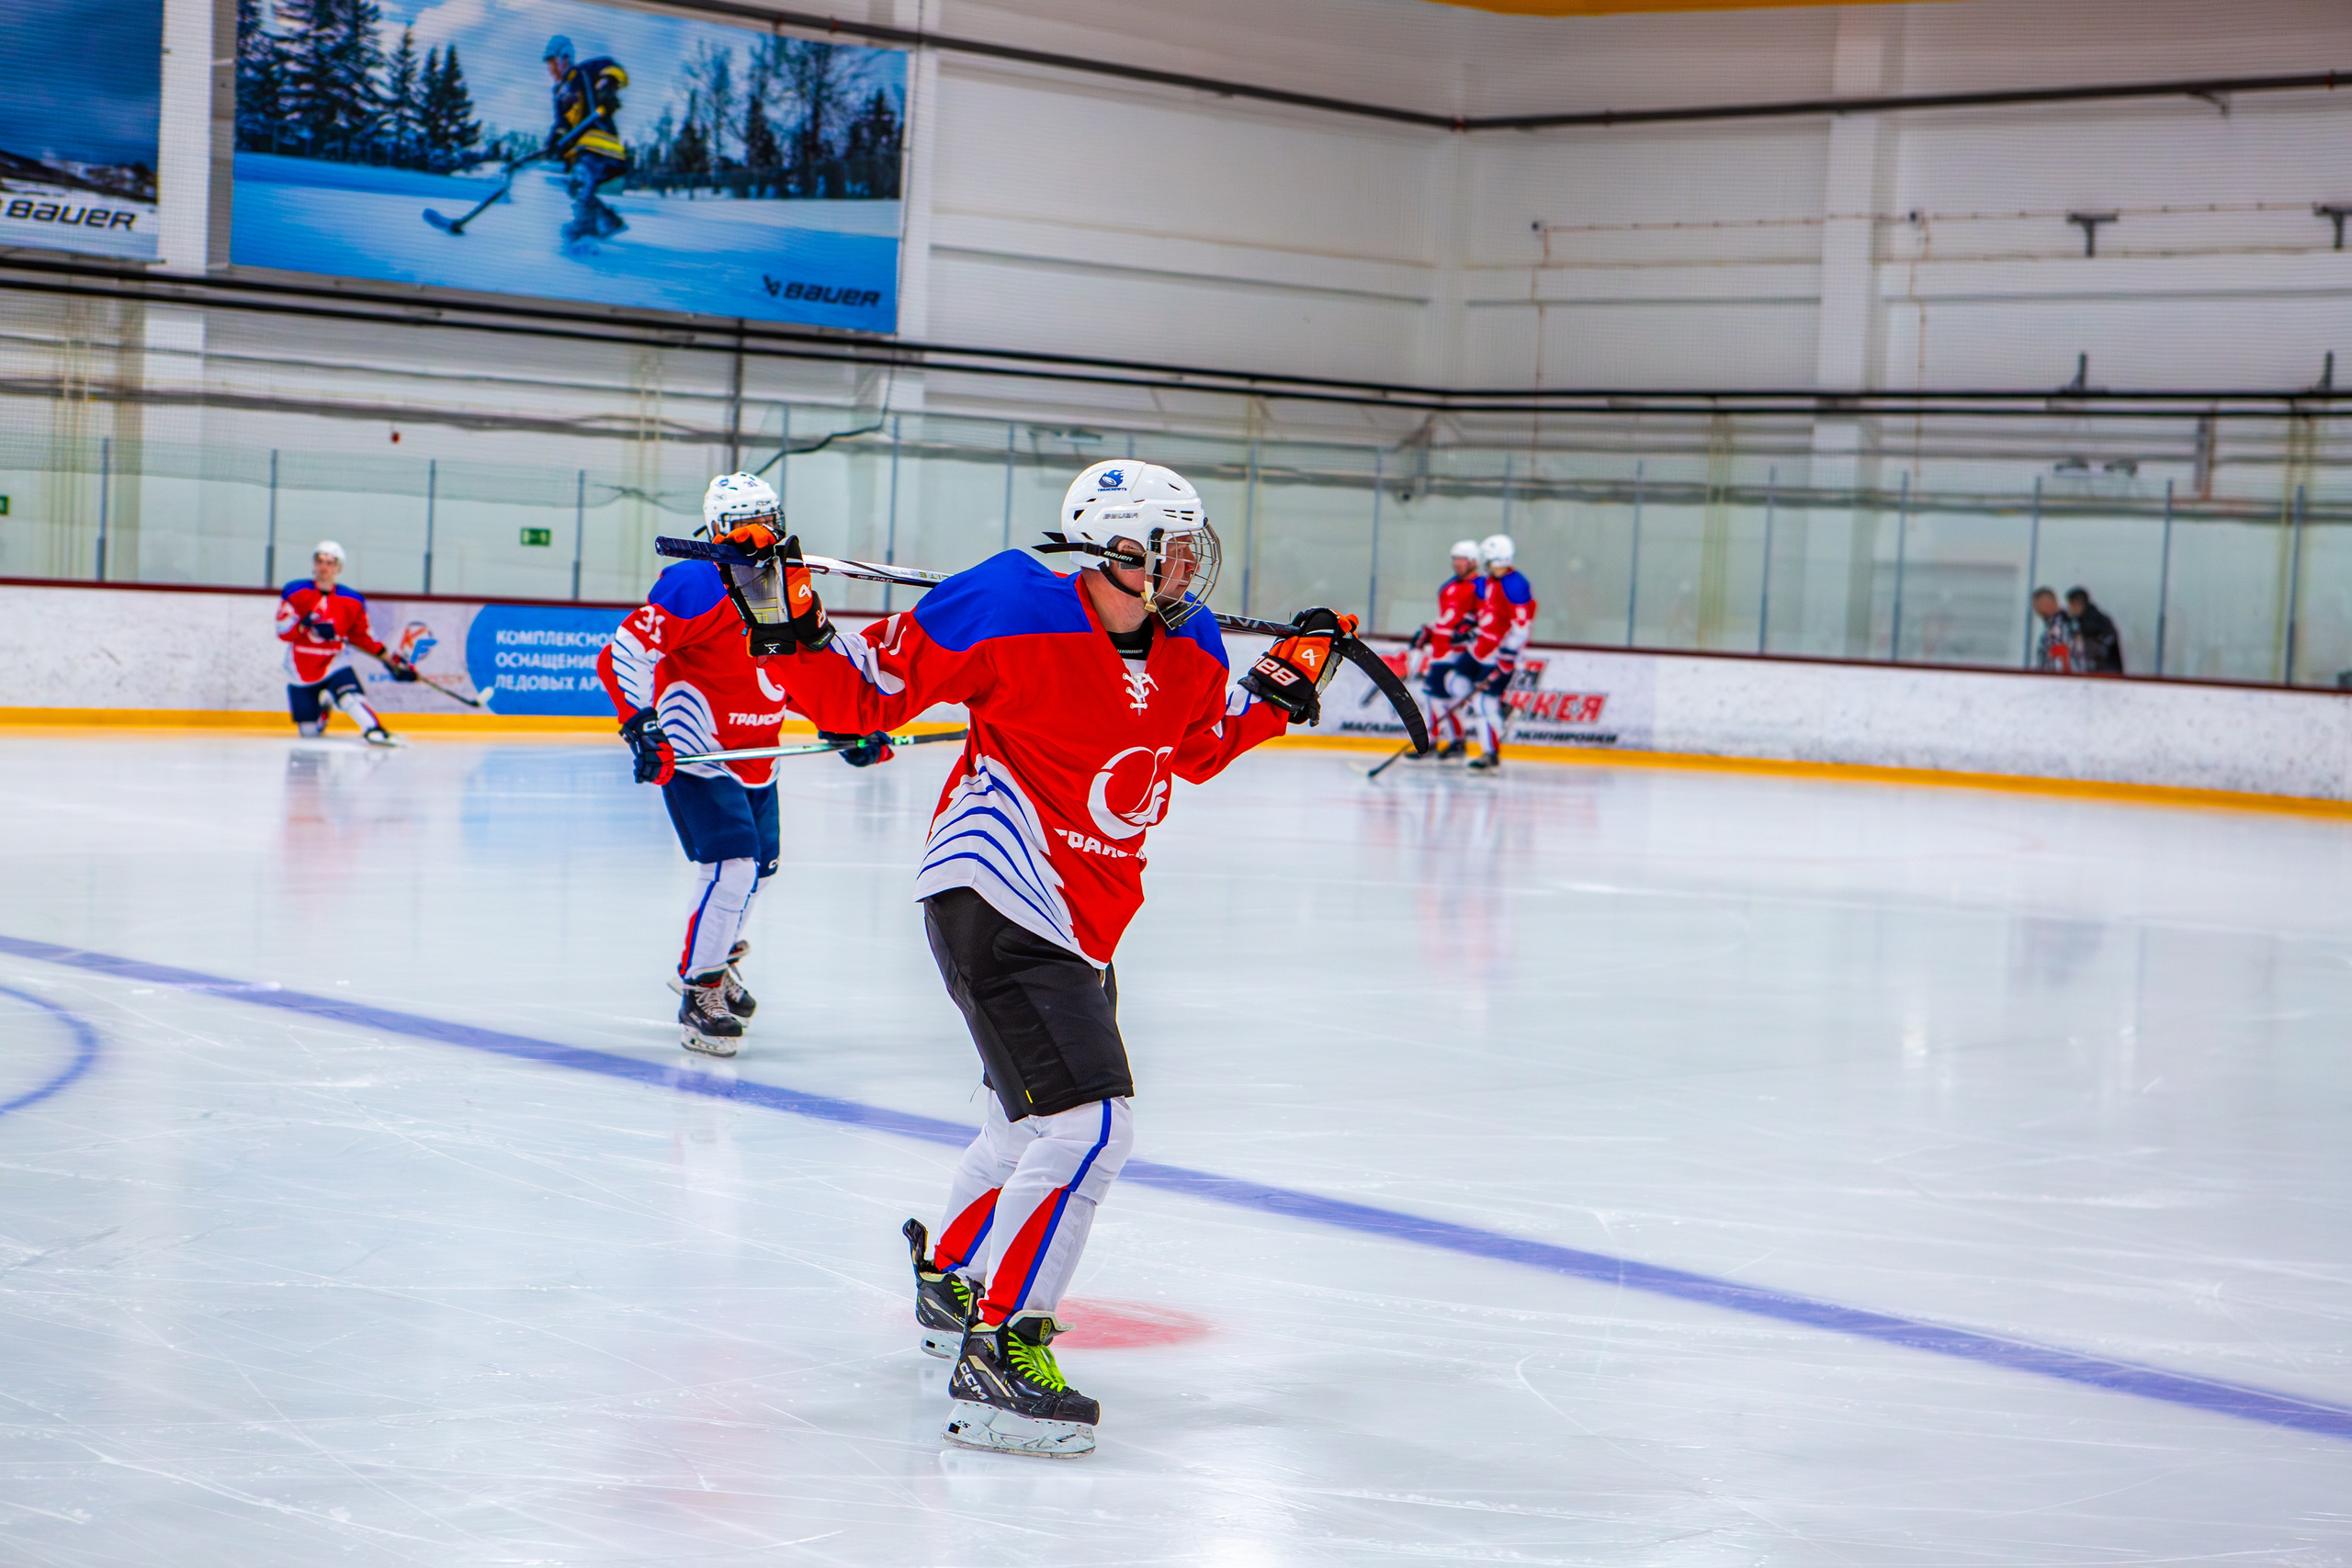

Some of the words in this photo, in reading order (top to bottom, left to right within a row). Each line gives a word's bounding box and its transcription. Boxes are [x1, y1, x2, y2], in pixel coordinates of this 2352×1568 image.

[6, 199, 136, 231] BAUER
[785, 281, 880, 307] BAUER
[1103, 550, 1134, 561] BAUER
[494, 673, 574, 692] ЛЕДОВЫХ
[728, 704, 786, 727] ТРАНС
[1501, 689, 1605, 723] ККЕЯ
[959, 1361, 989, 1401] CCM
